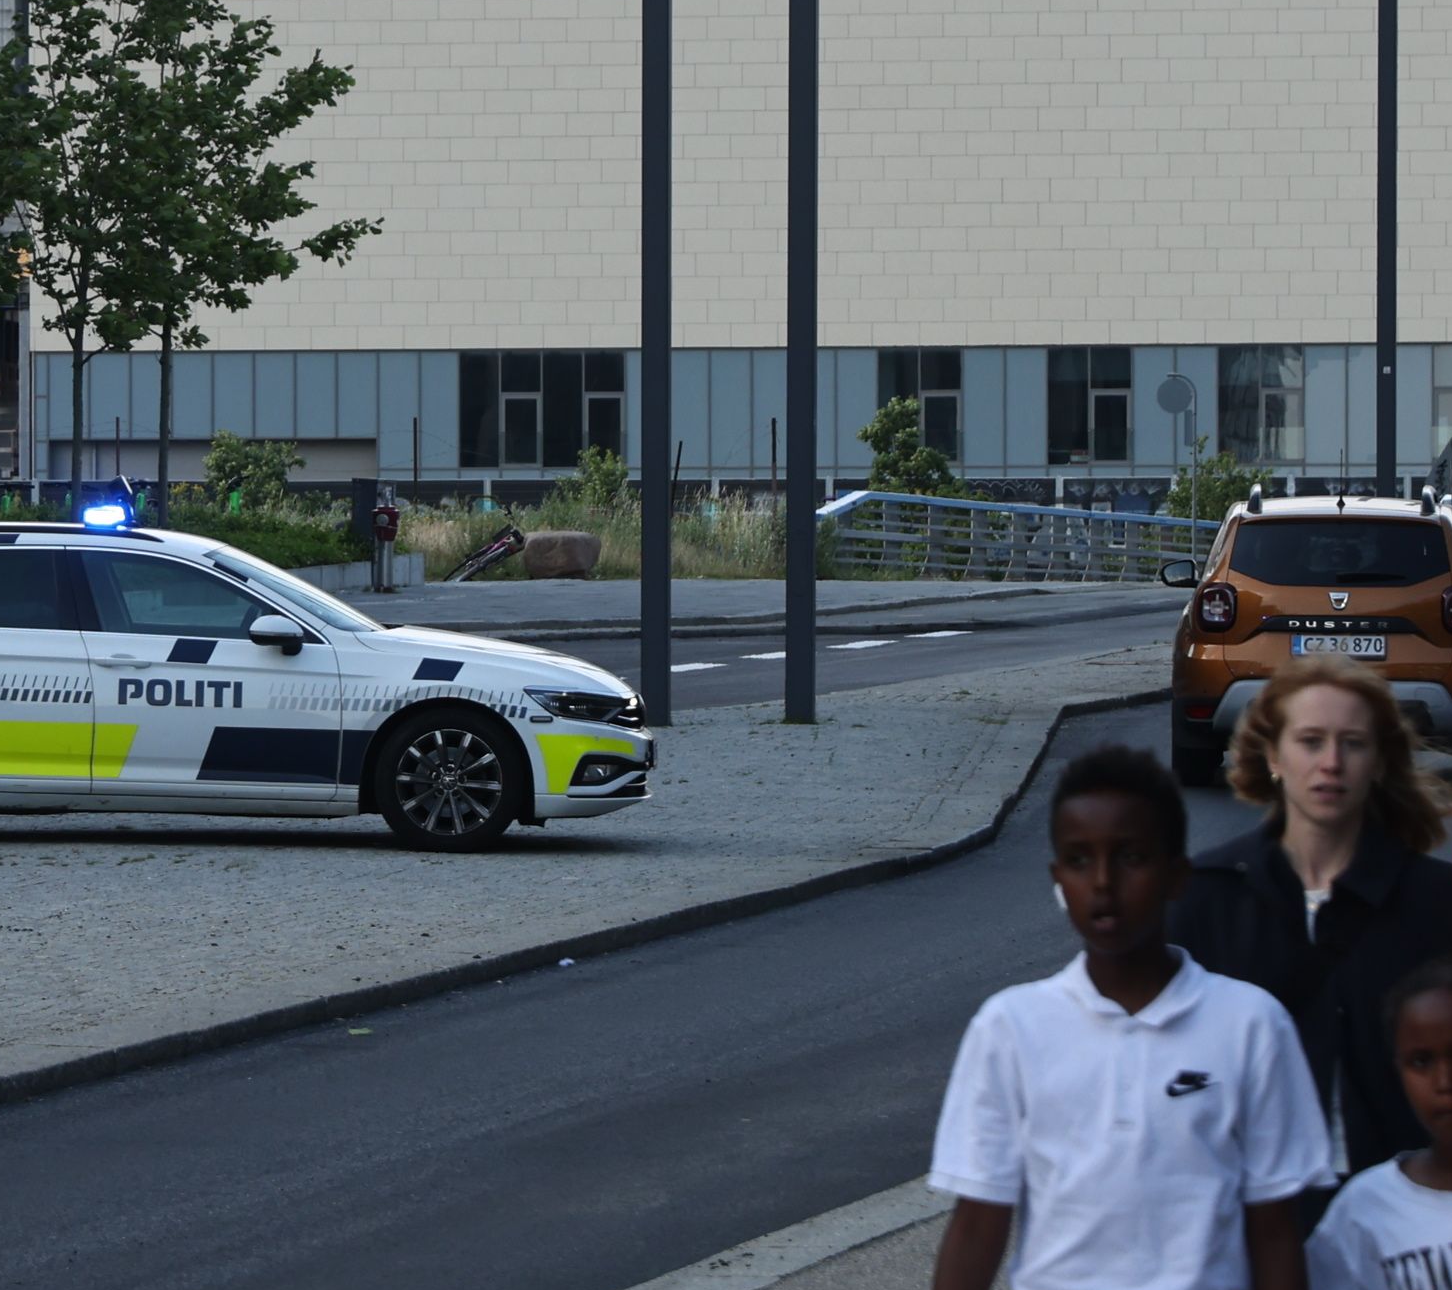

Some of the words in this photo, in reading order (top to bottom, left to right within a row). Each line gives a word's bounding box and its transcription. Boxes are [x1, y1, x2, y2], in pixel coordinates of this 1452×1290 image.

[1288, 620, 1388, 629] DUSTER
[1303, 637, 1325, 653] CZ
[1329, 637, 1349, 653] 36
[1353, 638, 1383, 653] 870
[118, 678, 243, 708] POLITI
